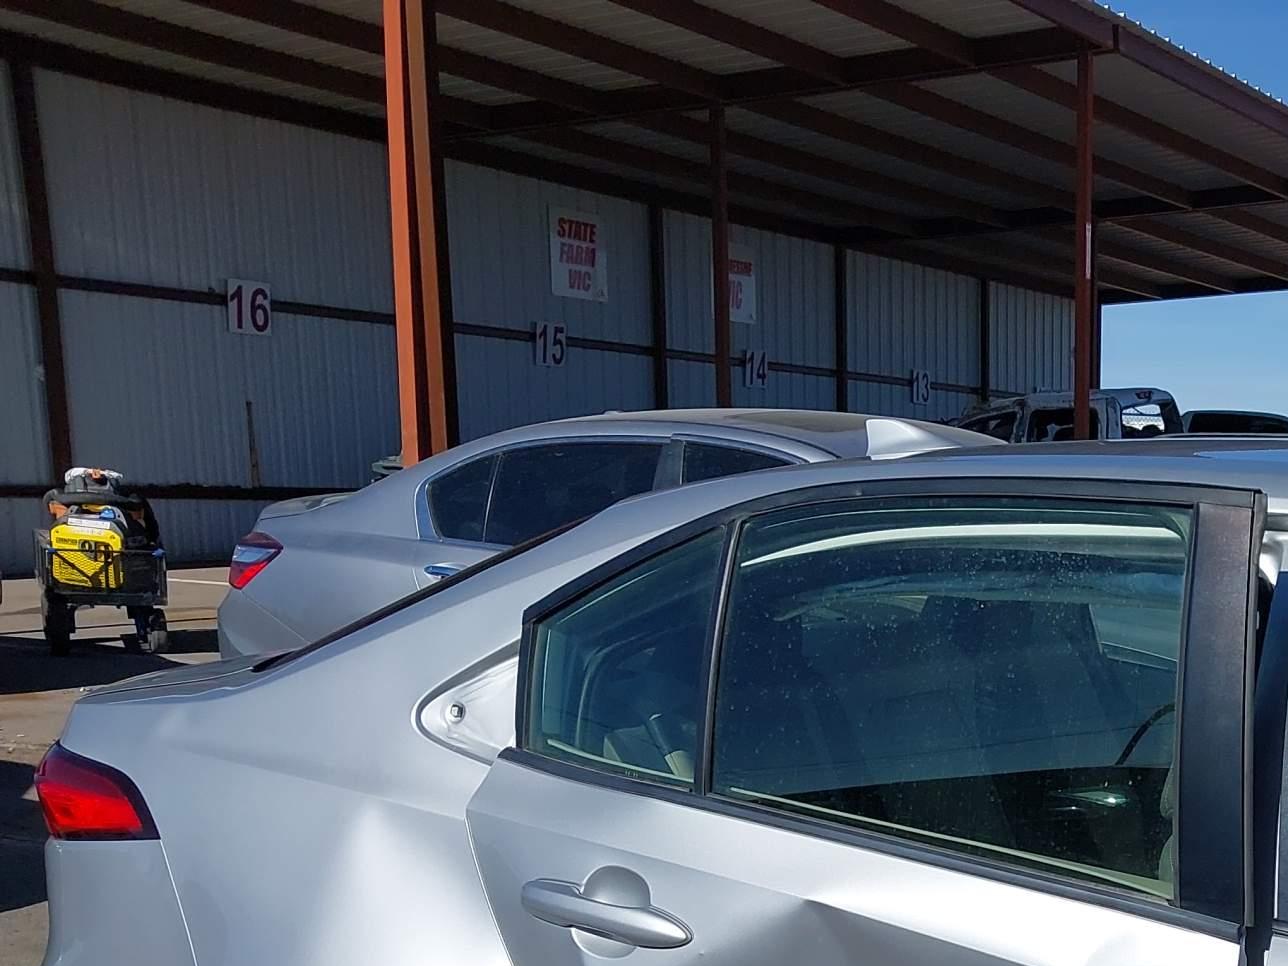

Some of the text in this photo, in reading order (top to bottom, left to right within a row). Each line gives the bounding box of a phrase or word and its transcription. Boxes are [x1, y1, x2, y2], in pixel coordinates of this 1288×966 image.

[557, 217, 598, 244] STATE
[559, 241, 596, 268] FARM
[568, 267, 593, 292] VIC
[229, 284, 270, 333] 16
[538, 324, 566, 366] 15
[746, 351, 768, 387] 14
[913, 371, 931, 404] 13
